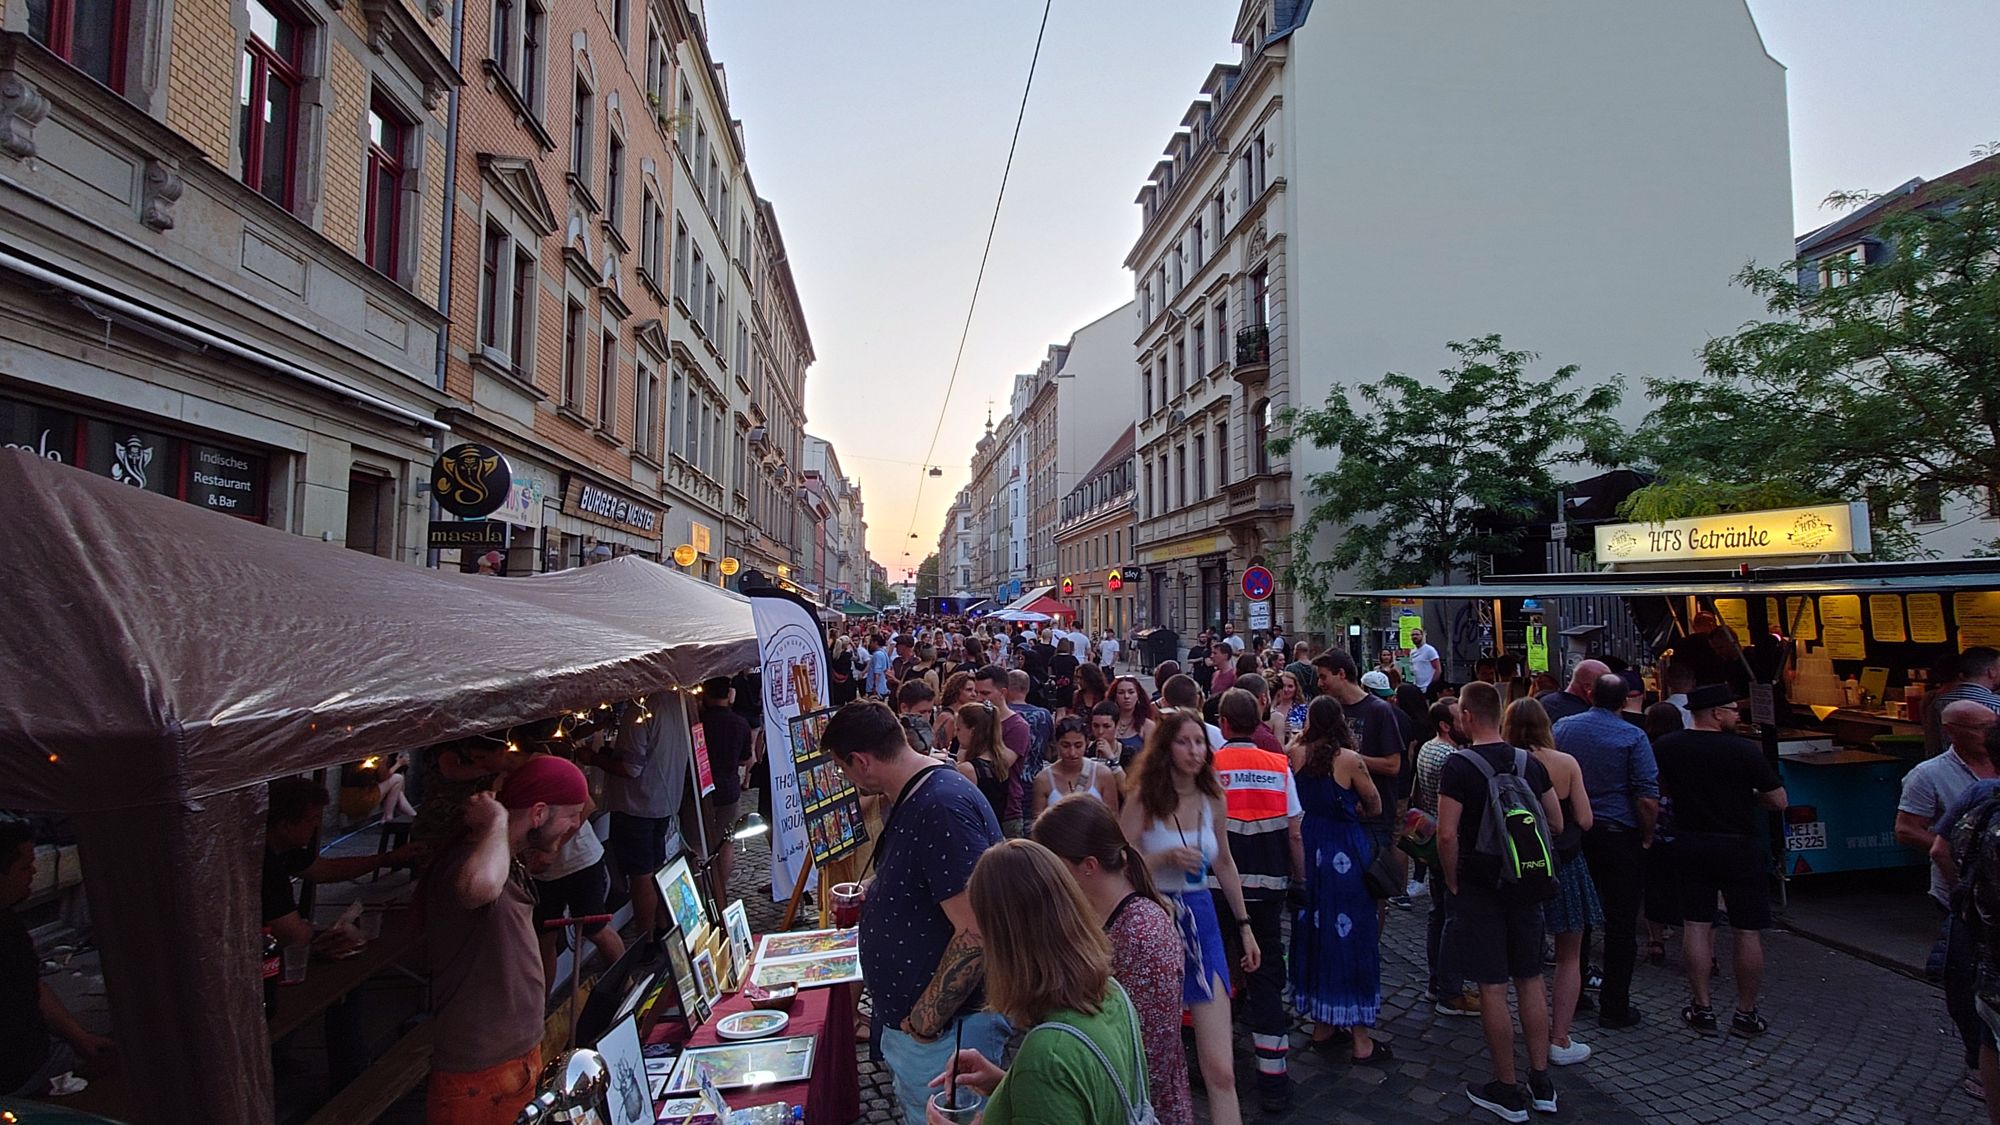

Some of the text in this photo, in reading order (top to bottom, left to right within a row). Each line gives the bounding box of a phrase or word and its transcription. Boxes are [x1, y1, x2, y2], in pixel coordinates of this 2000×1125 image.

[200, 451, 248, 471] Indisches
[194, 472, 251, 492] Restaurant
[208, 494, 237, 508] & Bar
[580, 486, 656, 533] BURGER MEISTER
[431, 523, 503, 543] masala
[1649, 528, 1682, 552] HFS
[1688, 525, 1771, 550] Getränke
[1124, 571, 1139, 580] sky
[1235, 772, 1277, 784] Malteser
[1804, 836, 1825, 848] 225
